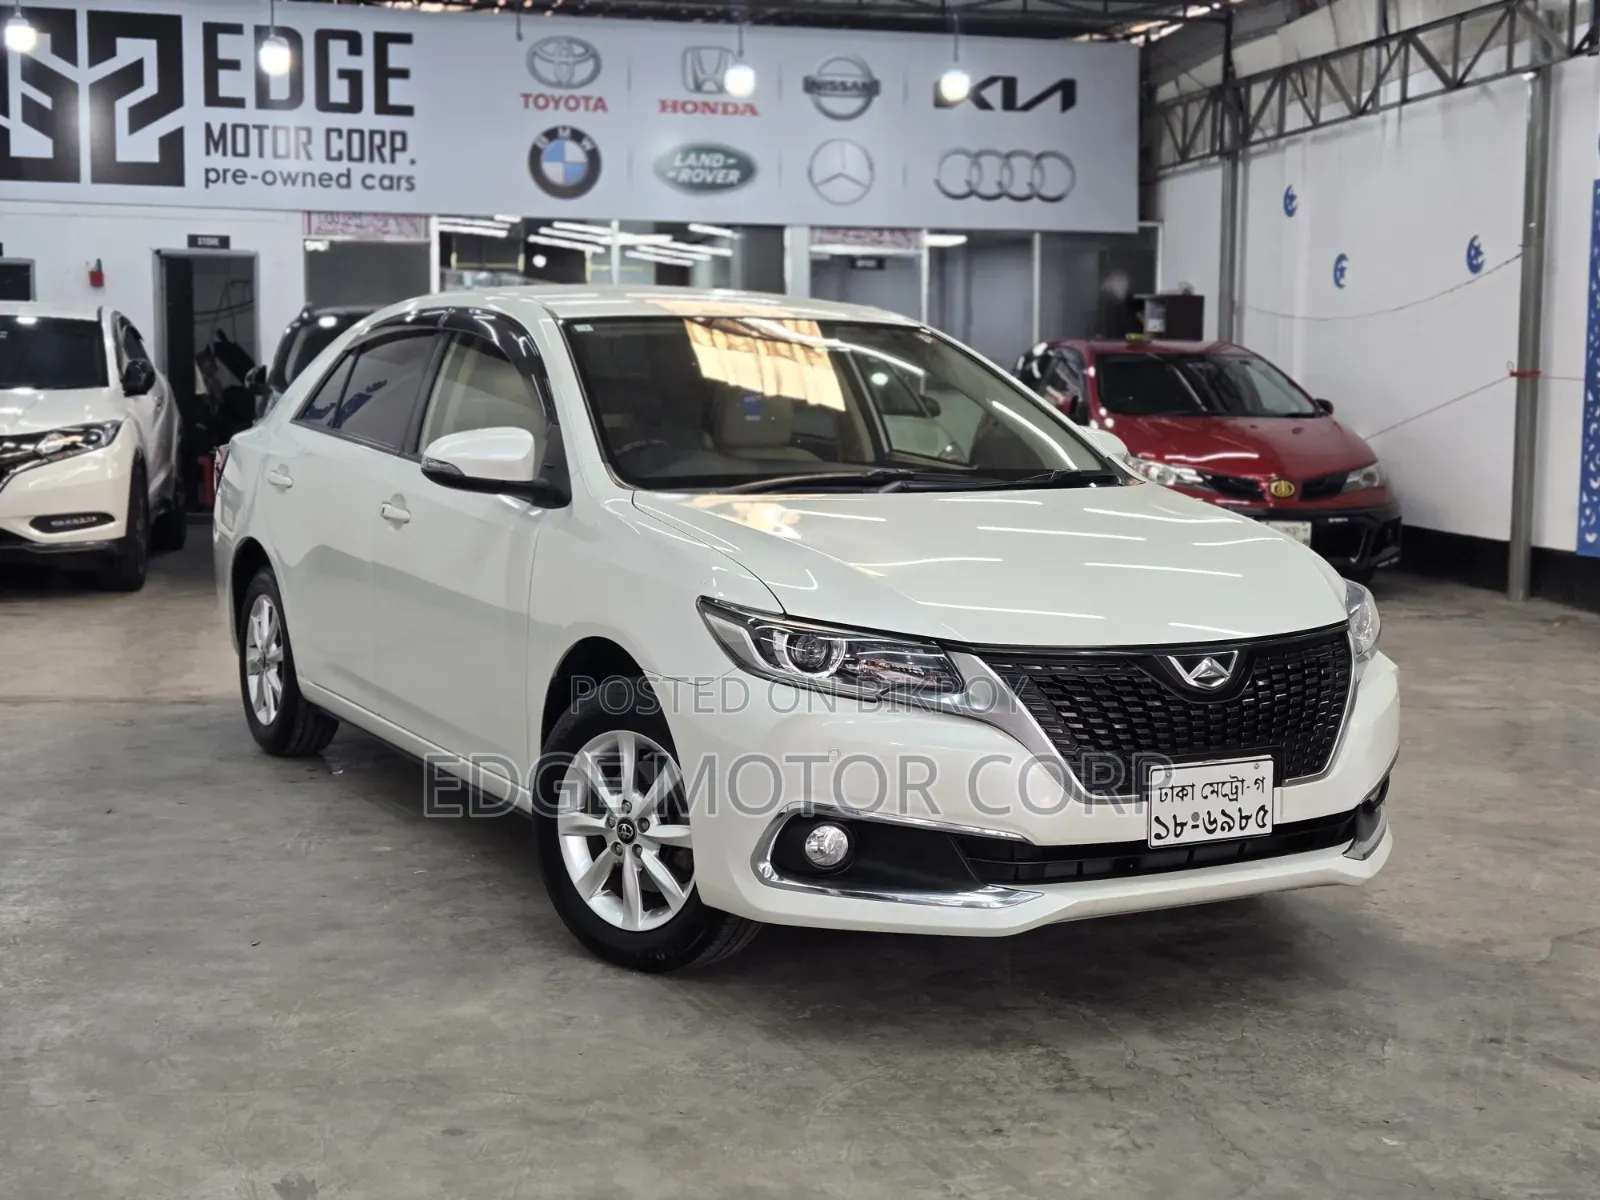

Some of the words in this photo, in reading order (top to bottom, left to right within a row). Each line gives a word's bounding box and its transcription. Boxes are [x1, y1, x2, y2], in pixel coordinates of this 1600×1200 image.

[202, 21, 415, 117] EDGE
[809, 78, 875, 95] NISSAN
[520, 92, 609, 113] TOYOTA
[658, 99, 760, 116] HONDA
[204, 121, 313, 161] MOTOR
[325, 127, 416, 166] CORP.
[533, 126, 597, 151] BMW
[204, 166, 352, 190] pre-owned
[361, 172, 416, 192] cars
[1158, 783, 1196, 803] ঢাকা
[1153, 804, 1269, 840] ১৮-৬৯৮৫
